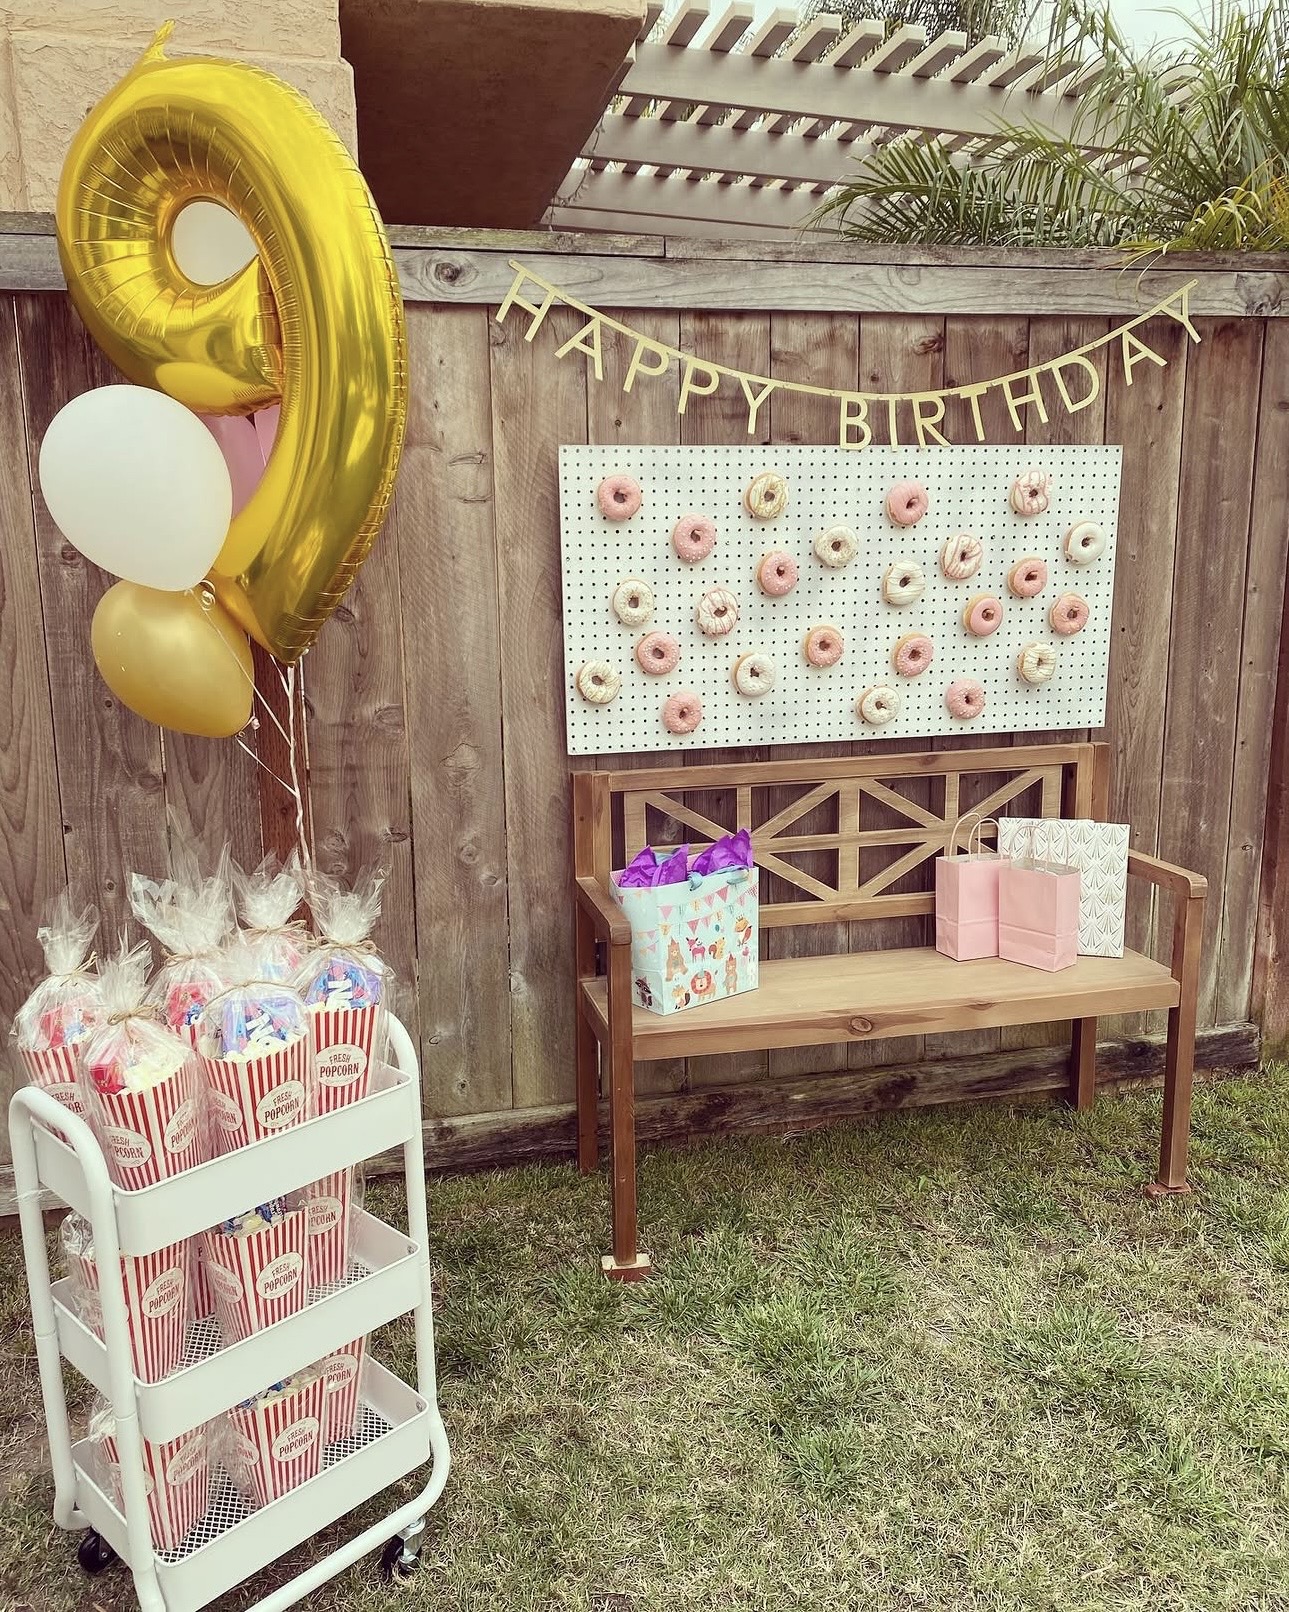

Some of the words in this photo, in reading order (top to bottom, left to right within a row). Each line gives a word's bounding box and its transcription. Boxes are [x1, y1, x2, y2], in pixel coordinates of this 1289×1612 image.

[495, 267, 777, 435] HAPPY
[839, 287, 1201, 451] BIRTHDAY
[329, 1053, 352, 1064] FRESH
[319, 1063, 360, 1078] POPCORN
[273, 1090, 293, 1107] FRESH
[264, 1096, 300, 1123] POPCORN
[113, 1145, 145, 1159] PCORN
[309, 1211, 337, 1227] PCORN
[271, 1262, 291, 1279] FRESH
[156, 1279, 174, 1295] FRESH
[263, 1266, 298, 1294] POPCORN
[148, 1283, 180, 1313] POPCORN
[326, 1367, 352, 1382] PCORN
[286, 1426, 309, 1442] FRESH
[279, 1430, 314, 1458] POPCORN
